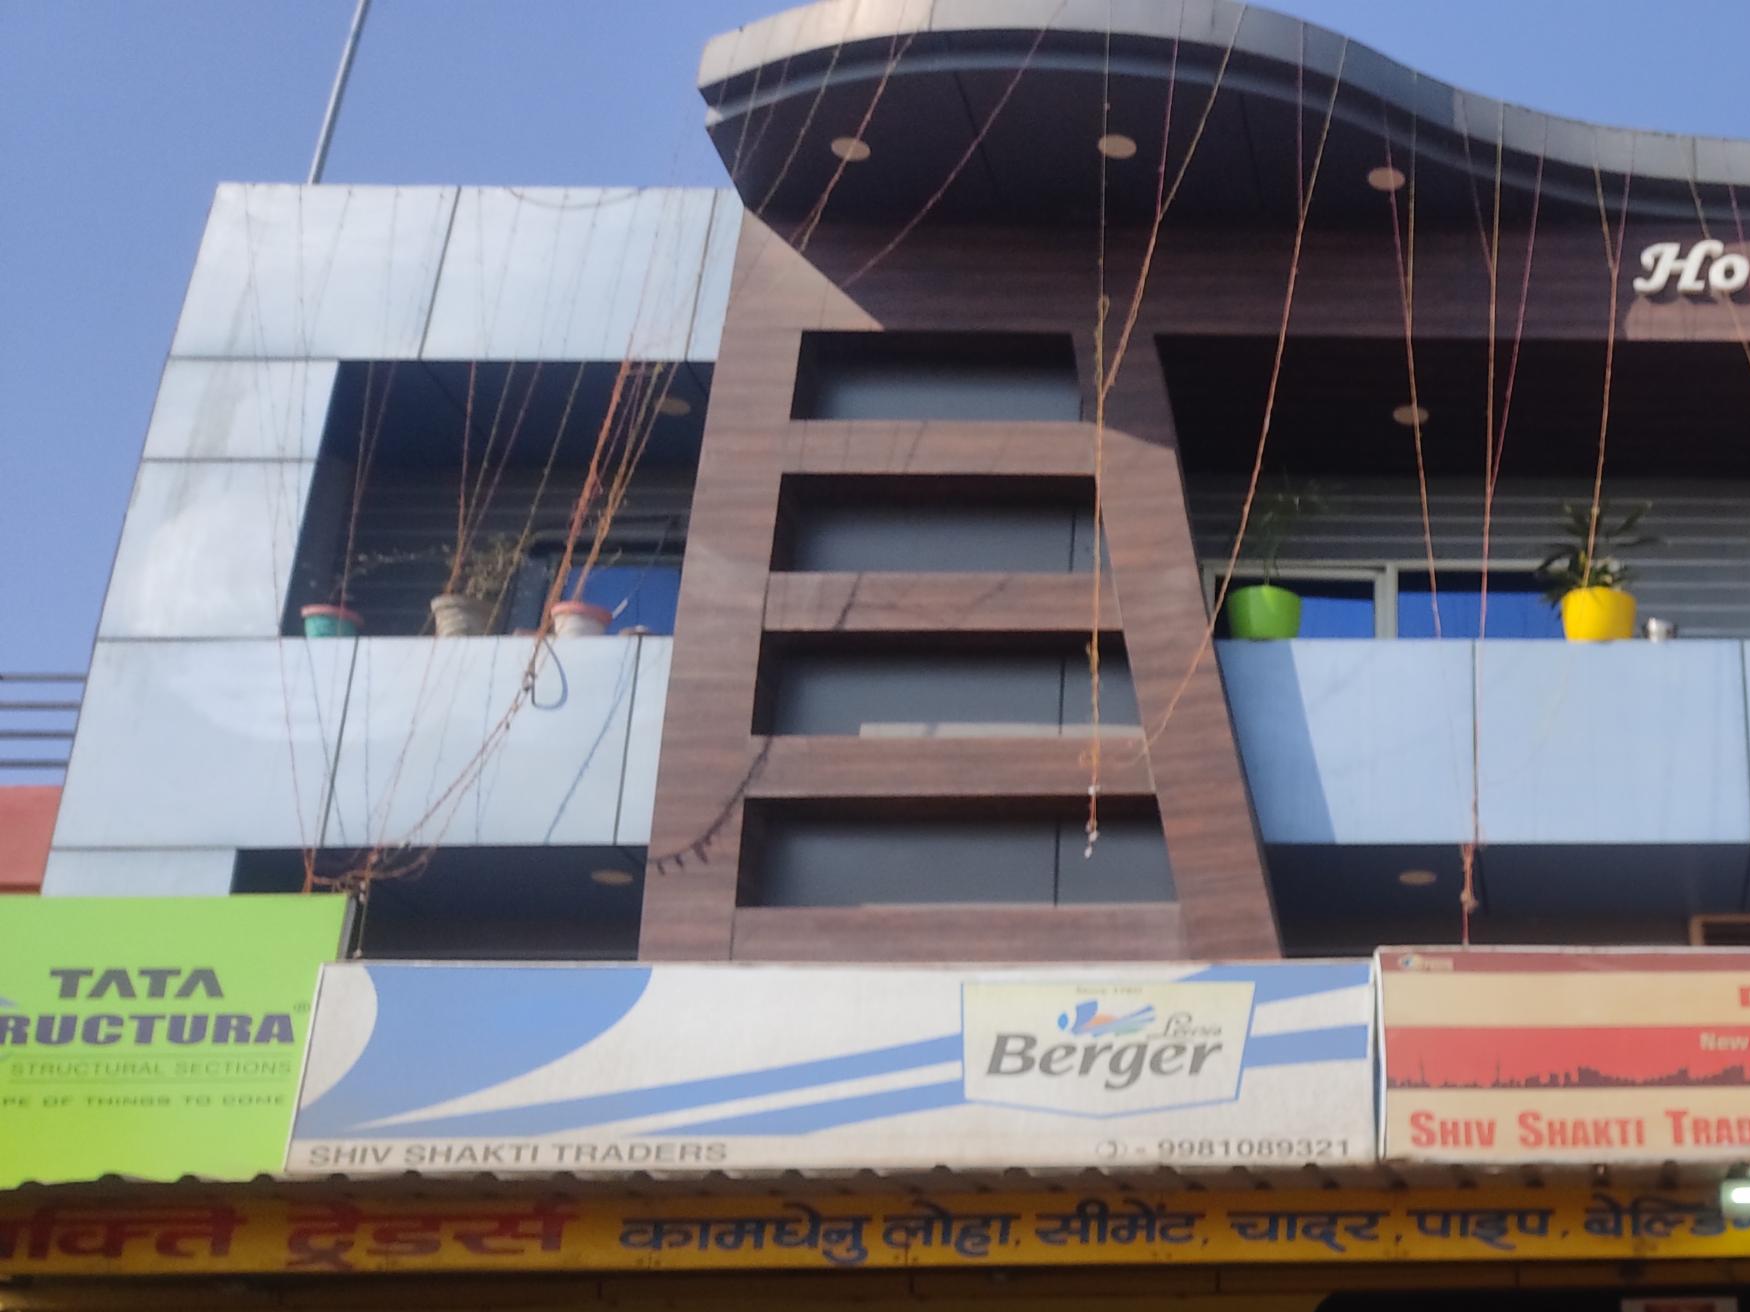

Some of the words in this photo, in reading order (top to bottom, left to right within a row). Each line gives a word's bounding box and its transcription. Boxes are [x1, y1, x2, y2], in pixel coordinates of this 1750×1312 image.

[50, 968, 224, 999] TATA
[1700, 1031, 1749, 1051] New
[11, 1060, 163, 1077] STRUCTURAL
[174, 1058, 292, 1076] SECTIONS
[986, 1032, 1224, 1091] Berger
[183, 1094, 211, 1108] TO
[309, 1145, 393, 1167] SHIV
[404, 1144, 540, 1165] SHAKTI
[552, 1143, 728, 1164] TRADERS
[1157, 1138, 1351, 1158] 9981089321
[619, 1203, 873, 1266] कामधेनु
